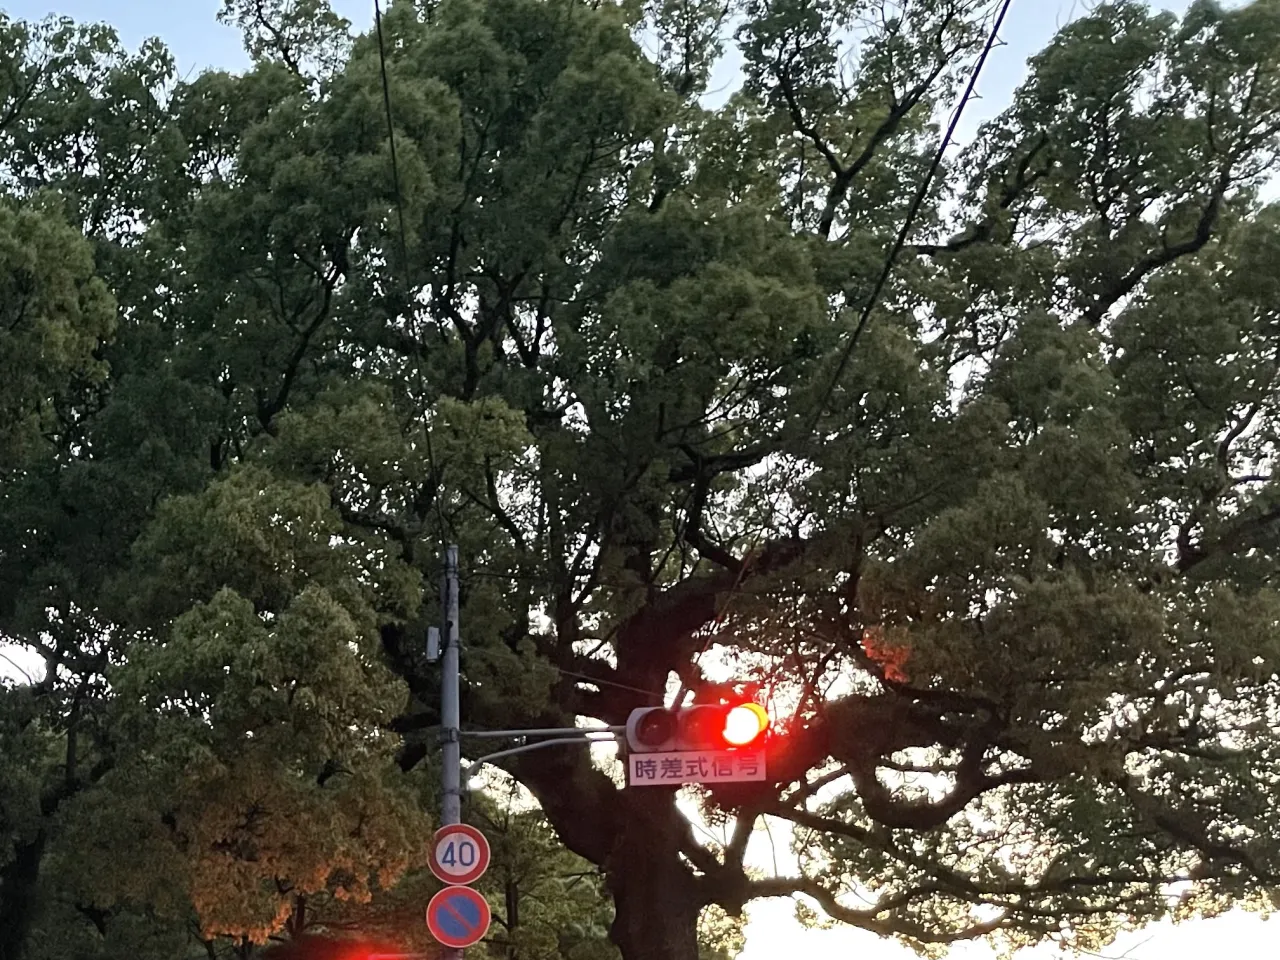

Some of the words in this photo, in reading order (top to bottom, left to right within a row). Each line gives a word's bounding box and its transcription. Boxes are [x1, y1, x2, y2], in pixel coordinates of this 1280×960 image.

[635, 756, 759, 779] 時差式信号
[442, 842, 474, 867] 40
